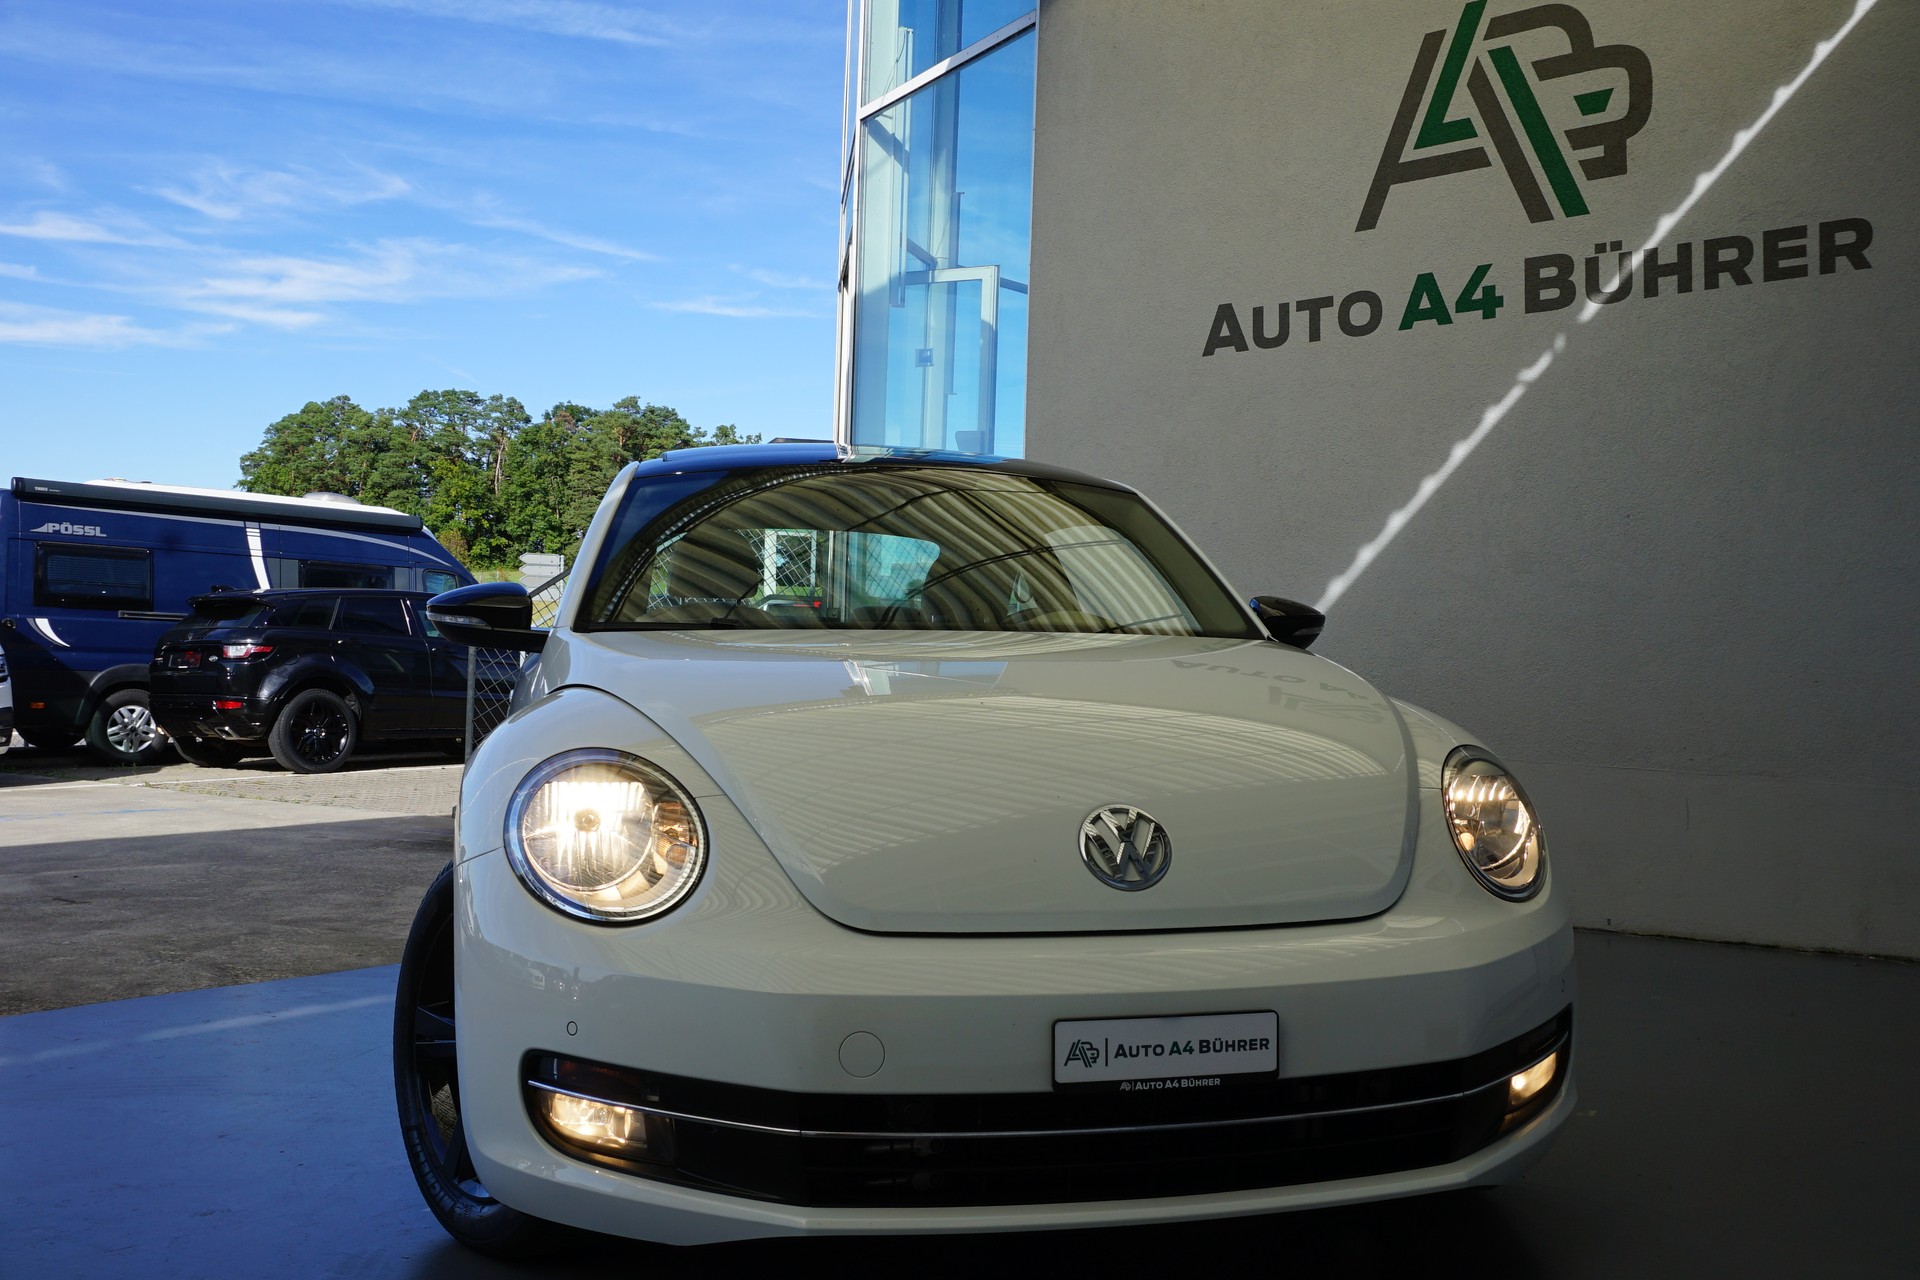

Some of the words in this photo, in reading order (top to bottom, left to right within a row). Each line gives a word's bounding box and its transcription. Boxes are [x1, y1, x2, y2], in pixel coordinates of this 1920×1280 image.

[1201, 290, 1383, 357] AUTO
[1398, 263, 1505, 331] A4
[1523, 217, 1874, 315] BÜHRER
[47, 522, 107, 537] PÖSSL
[1113, 1043, 1165, 1059] AUTO
[1168, 1040, 1195, 1056] A4
[1198, 1038, 1270, 1054] BÜHRER
[1135, 1081, 1163, 1091] AUTO
[1164, 1079, 1179, 1089] A4
[1180, 1078, 1221, 1088] BÜHRER
